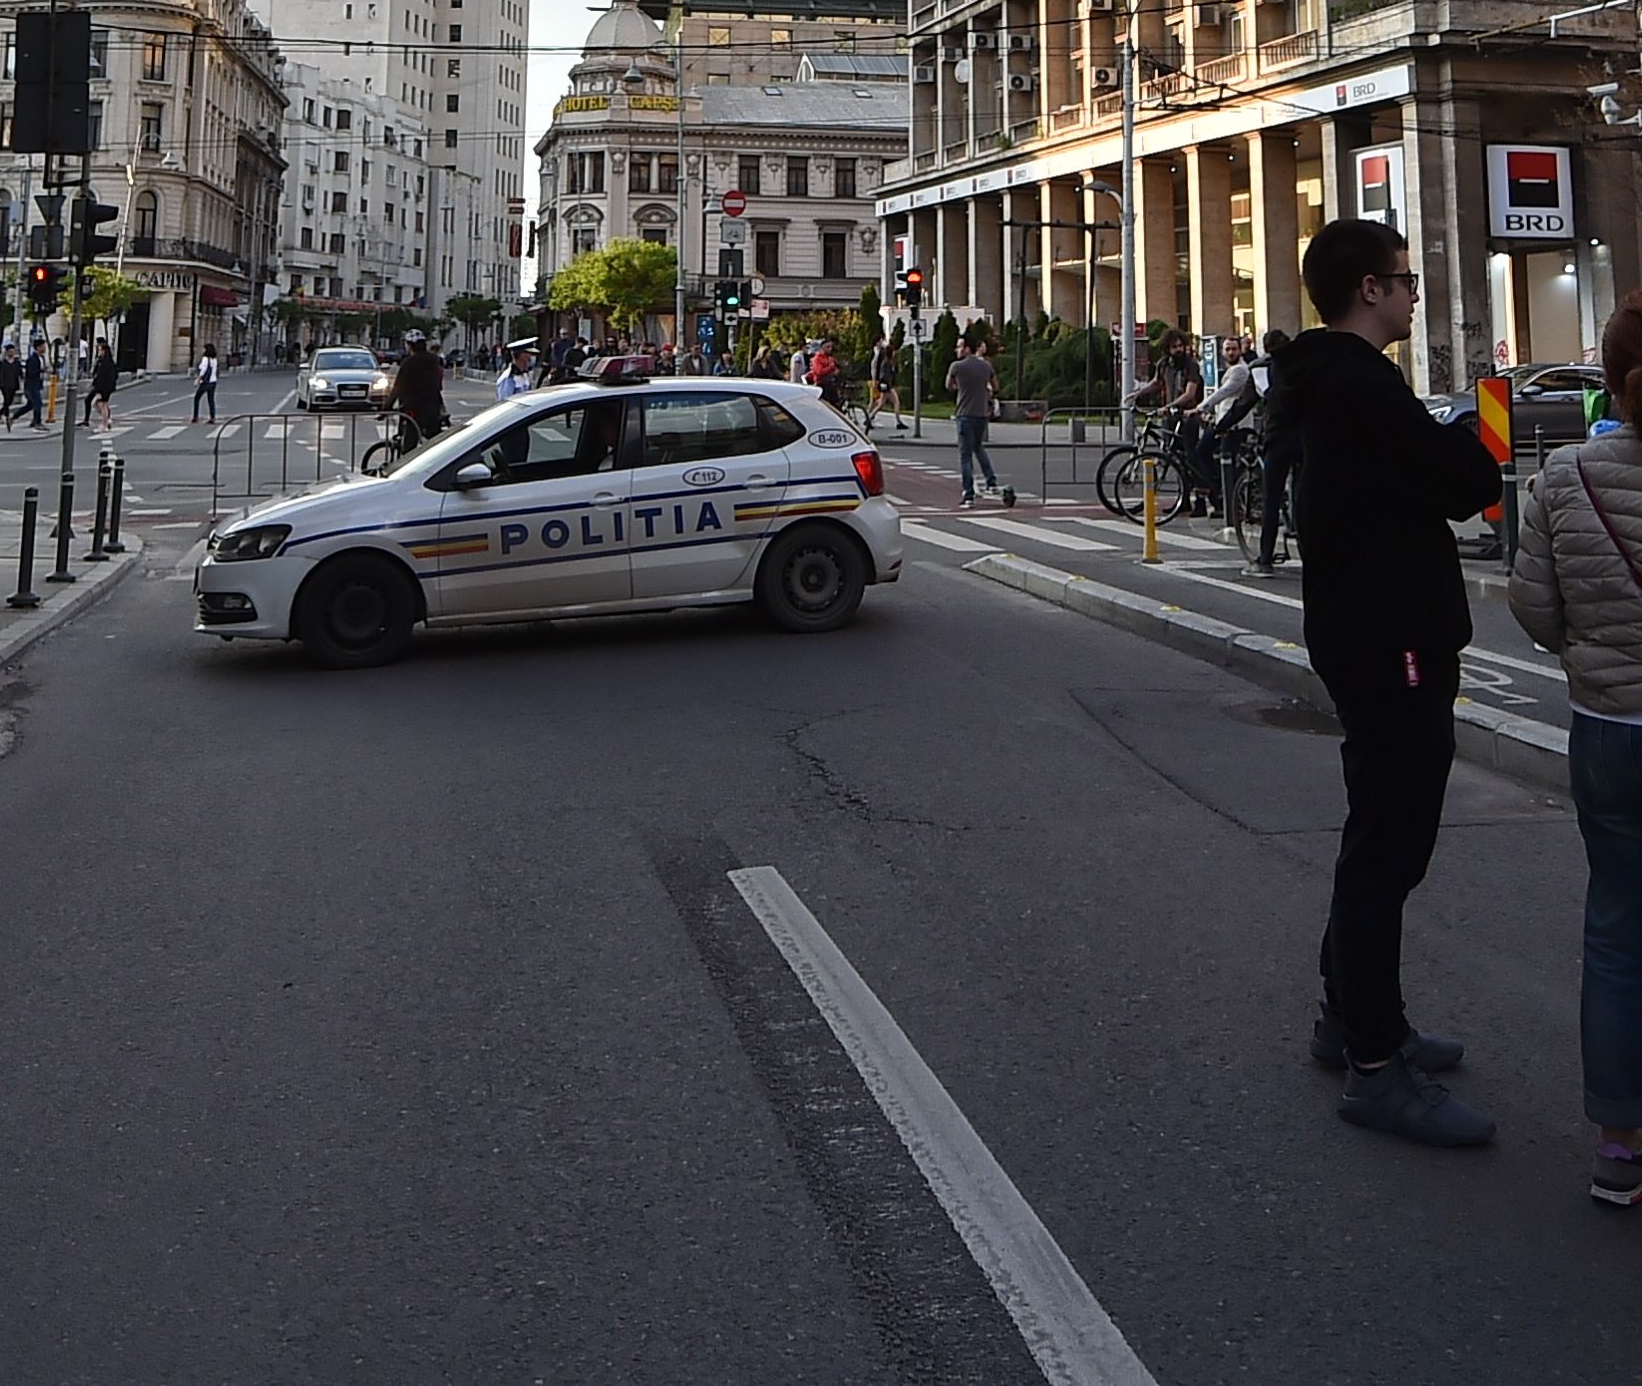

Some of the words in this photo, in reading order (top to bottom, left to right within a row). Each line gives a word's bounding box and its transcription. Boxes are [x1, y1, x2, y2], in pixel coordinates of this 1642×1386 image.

[1350, 84, 1374, 99] BRD
[565, 96, 608, 112] HOTEL
[1505, 214, 1564, 231] BRD
[818, 432, 848, 445] B-001
[699, 471, 717, 484] 112
[500, 501, 723, 554] POLITIA
